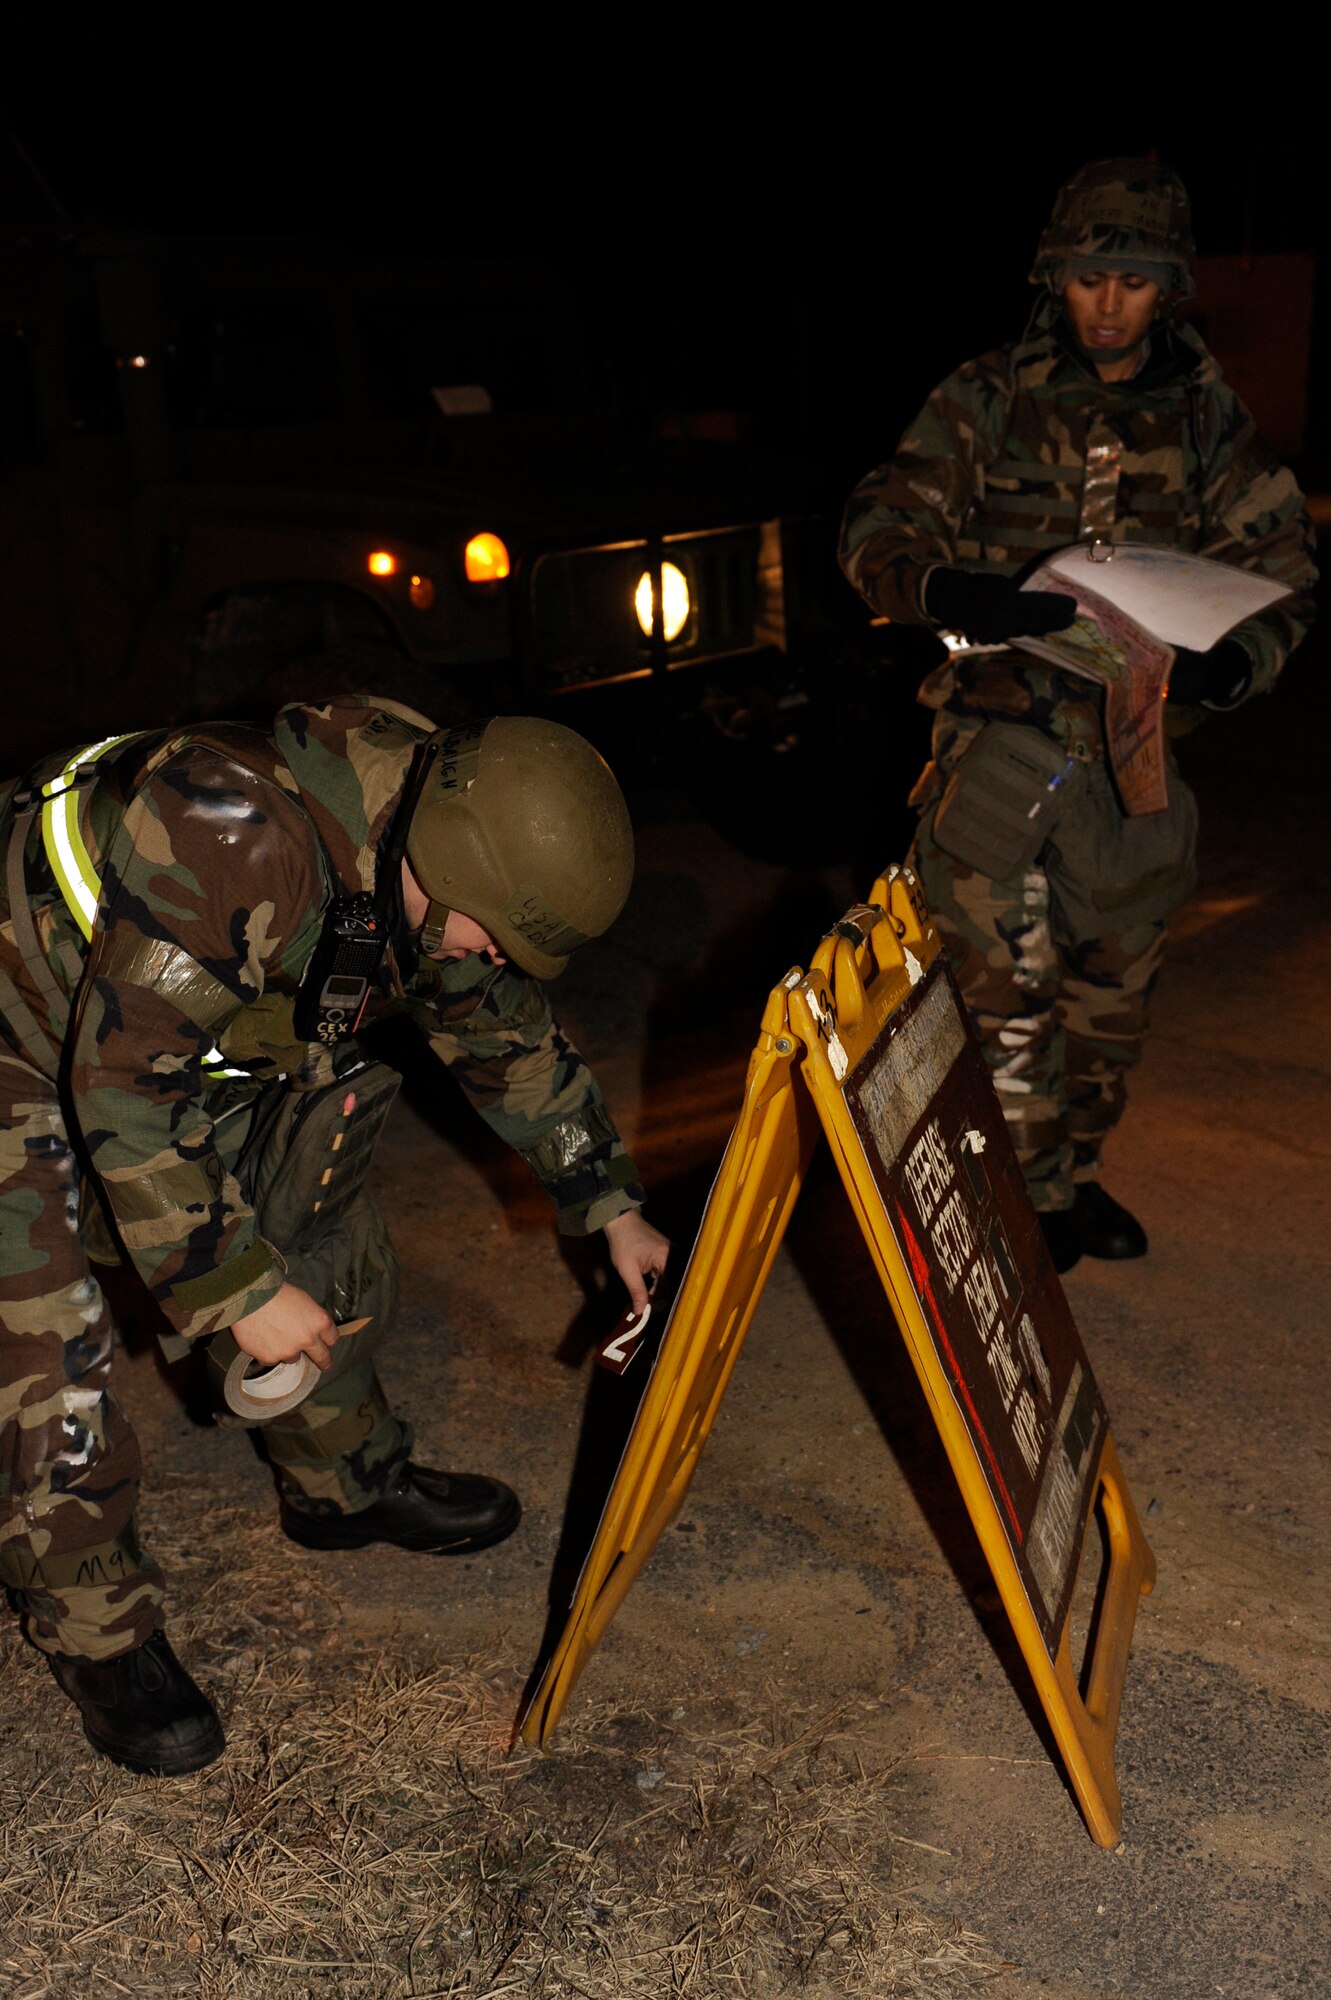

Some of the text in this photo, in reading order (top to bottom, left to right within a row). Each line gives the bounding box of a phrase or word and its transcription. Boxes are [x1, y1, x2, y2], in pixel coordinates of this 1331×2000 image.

[316, 1022, 348, 1033] CEX
[319, 1032, 339, 1042] 26
[904, 1117, 956, 1229] DEFENSE
[964, 1252, 999, 1345] CHEM
[601, 1303, 652, 1363] 2
